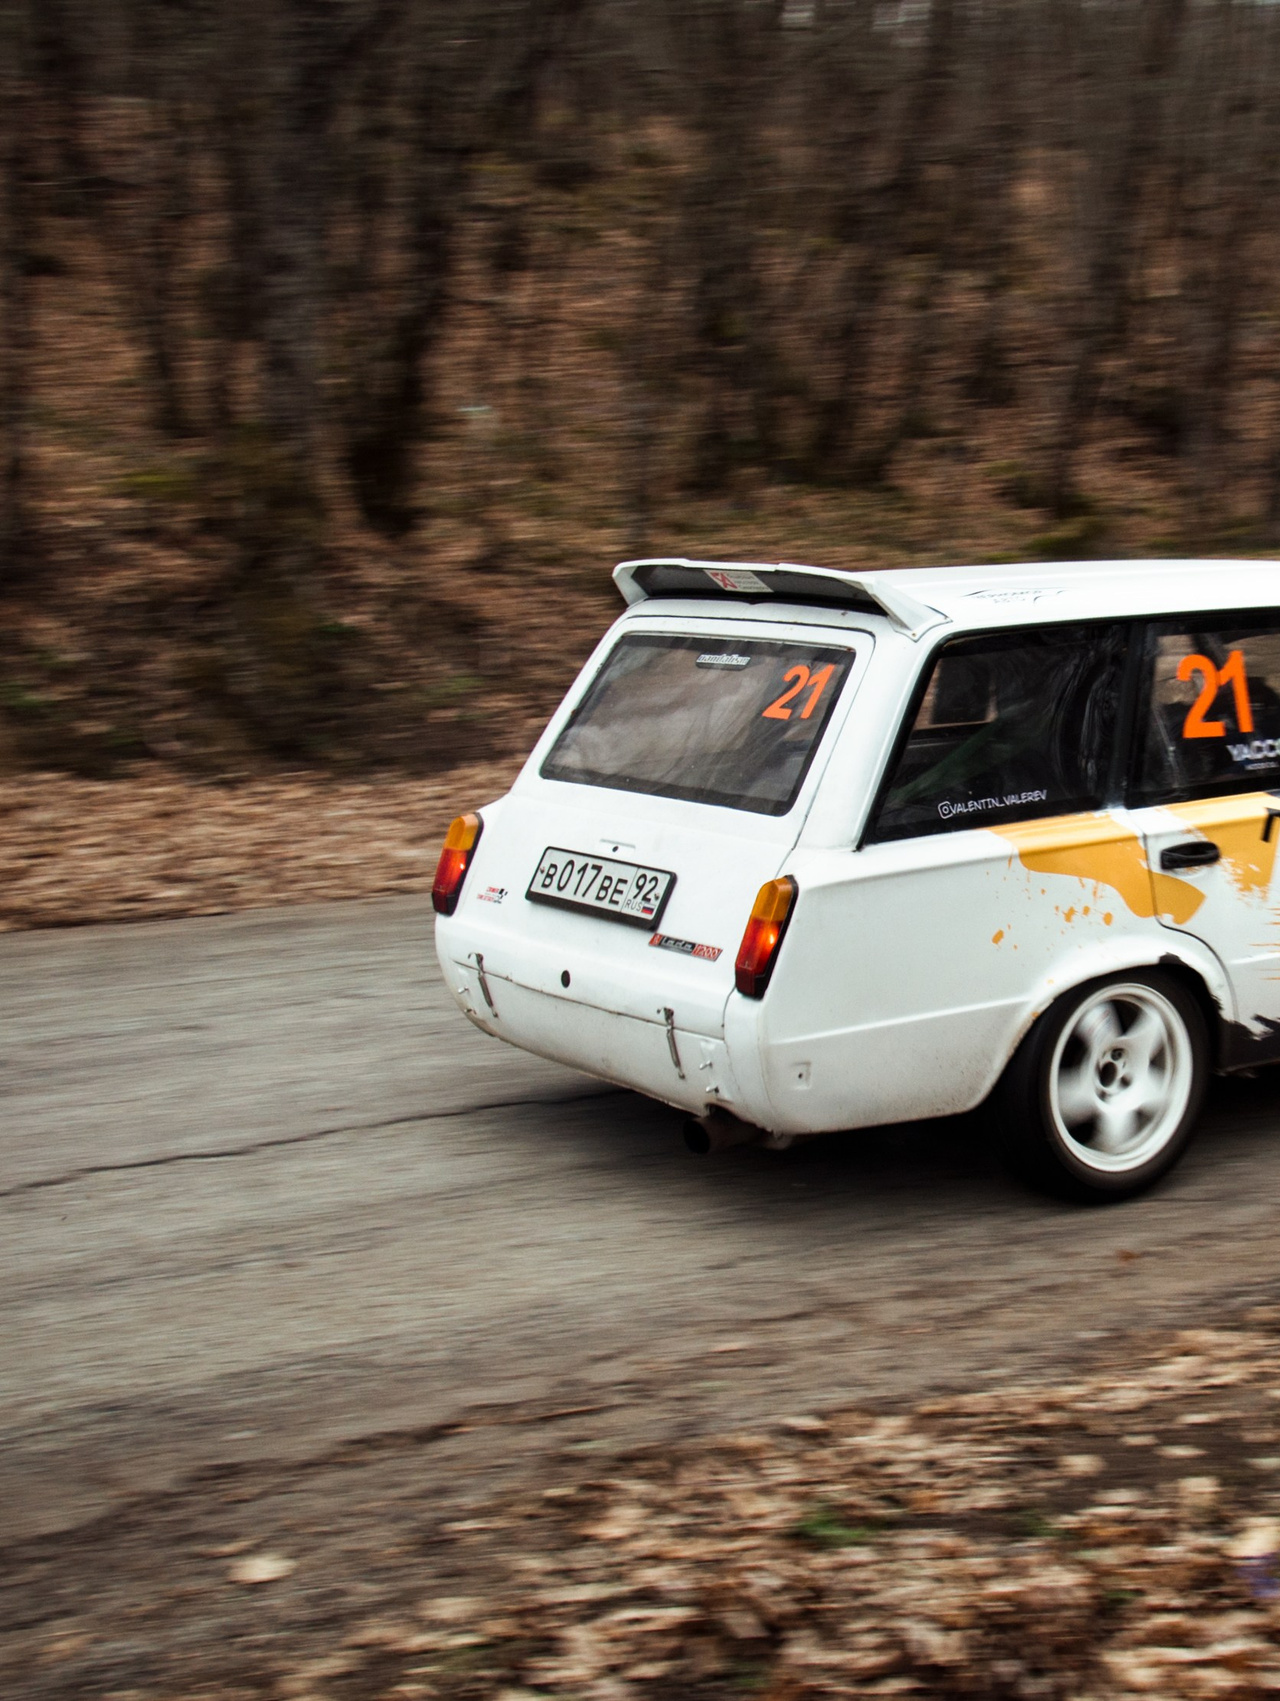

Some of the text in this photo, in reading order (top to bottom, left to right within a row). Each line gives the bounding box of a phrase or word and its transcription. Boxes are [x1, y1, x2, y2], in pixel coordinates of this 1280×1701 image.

[762, 664, 836, 720] 21
[1176, 649, 1254, 739] 21
[624, 898, 643, 912] RUS
[633, 873, 659, 902] 92
